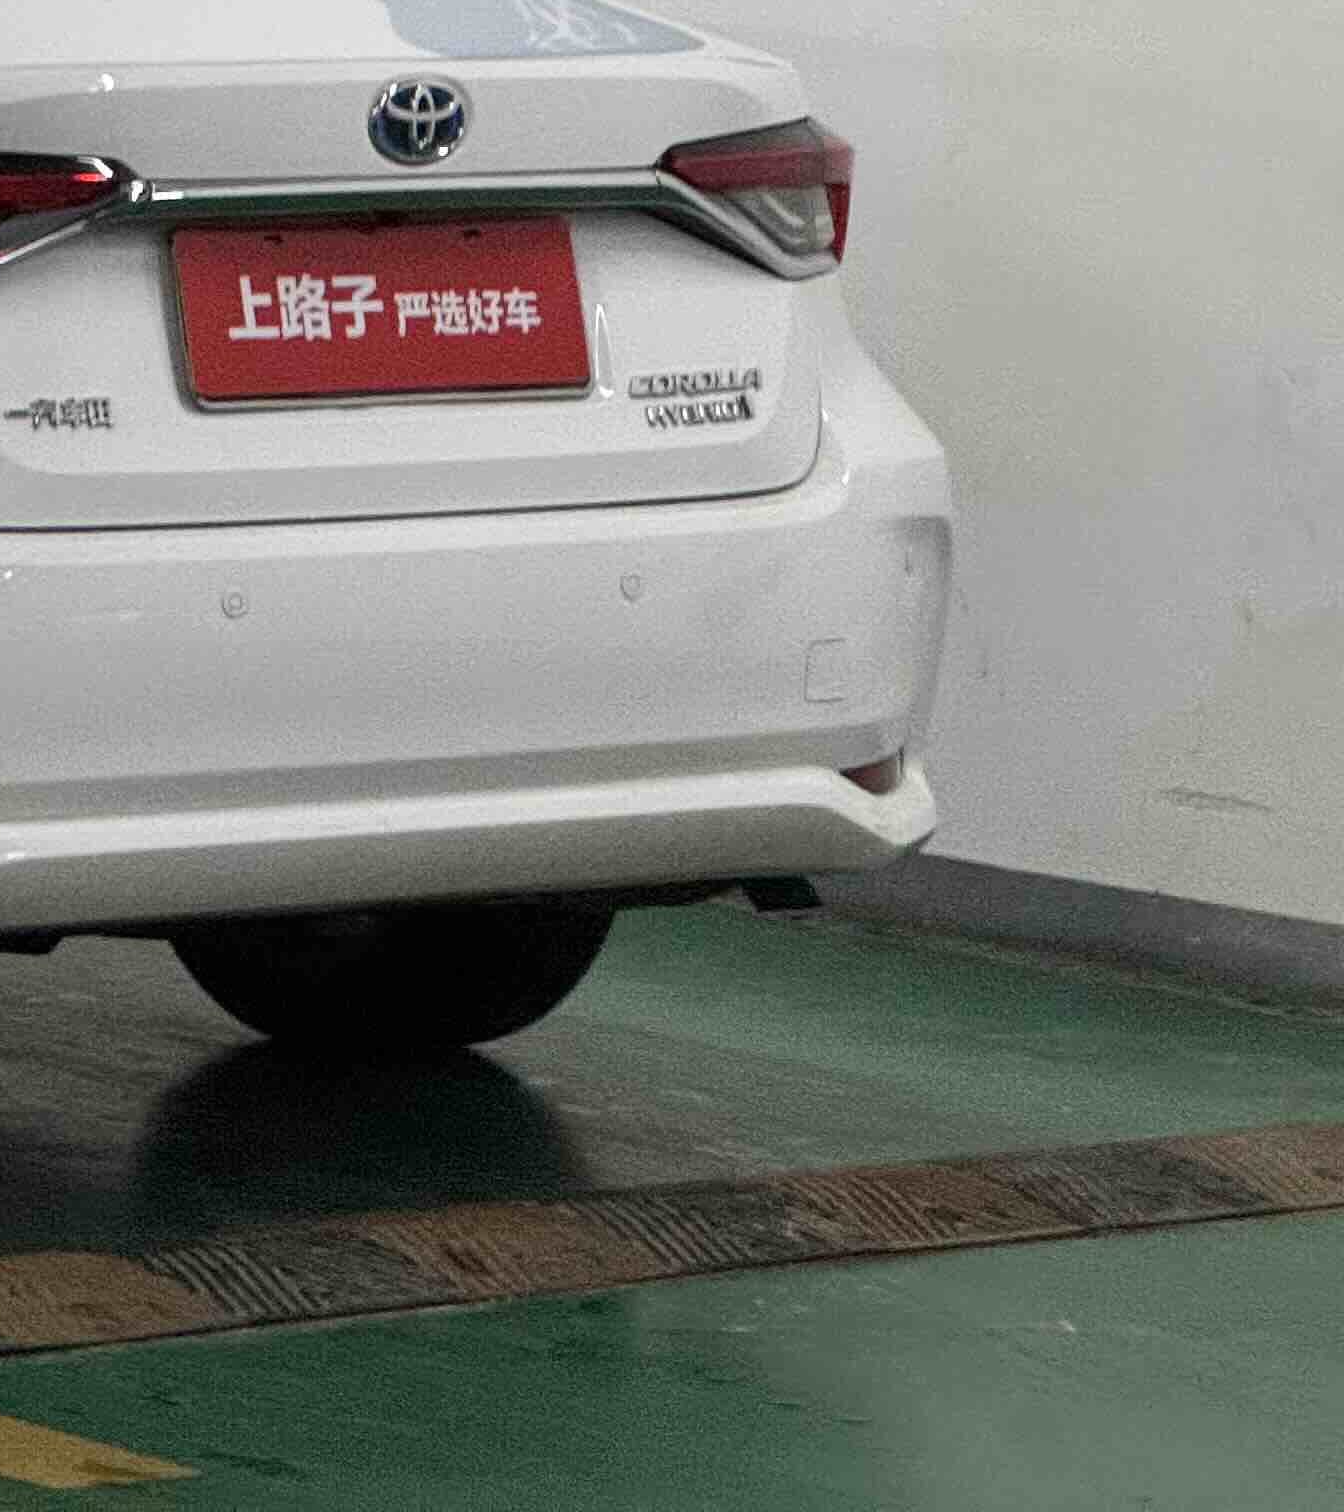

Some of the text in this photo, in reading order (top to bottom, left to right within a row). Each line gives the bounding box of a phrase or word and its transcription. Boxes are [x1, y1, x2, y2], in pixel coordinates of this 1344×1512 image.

[228, 272, 542, 341] 上路子 严选好车
